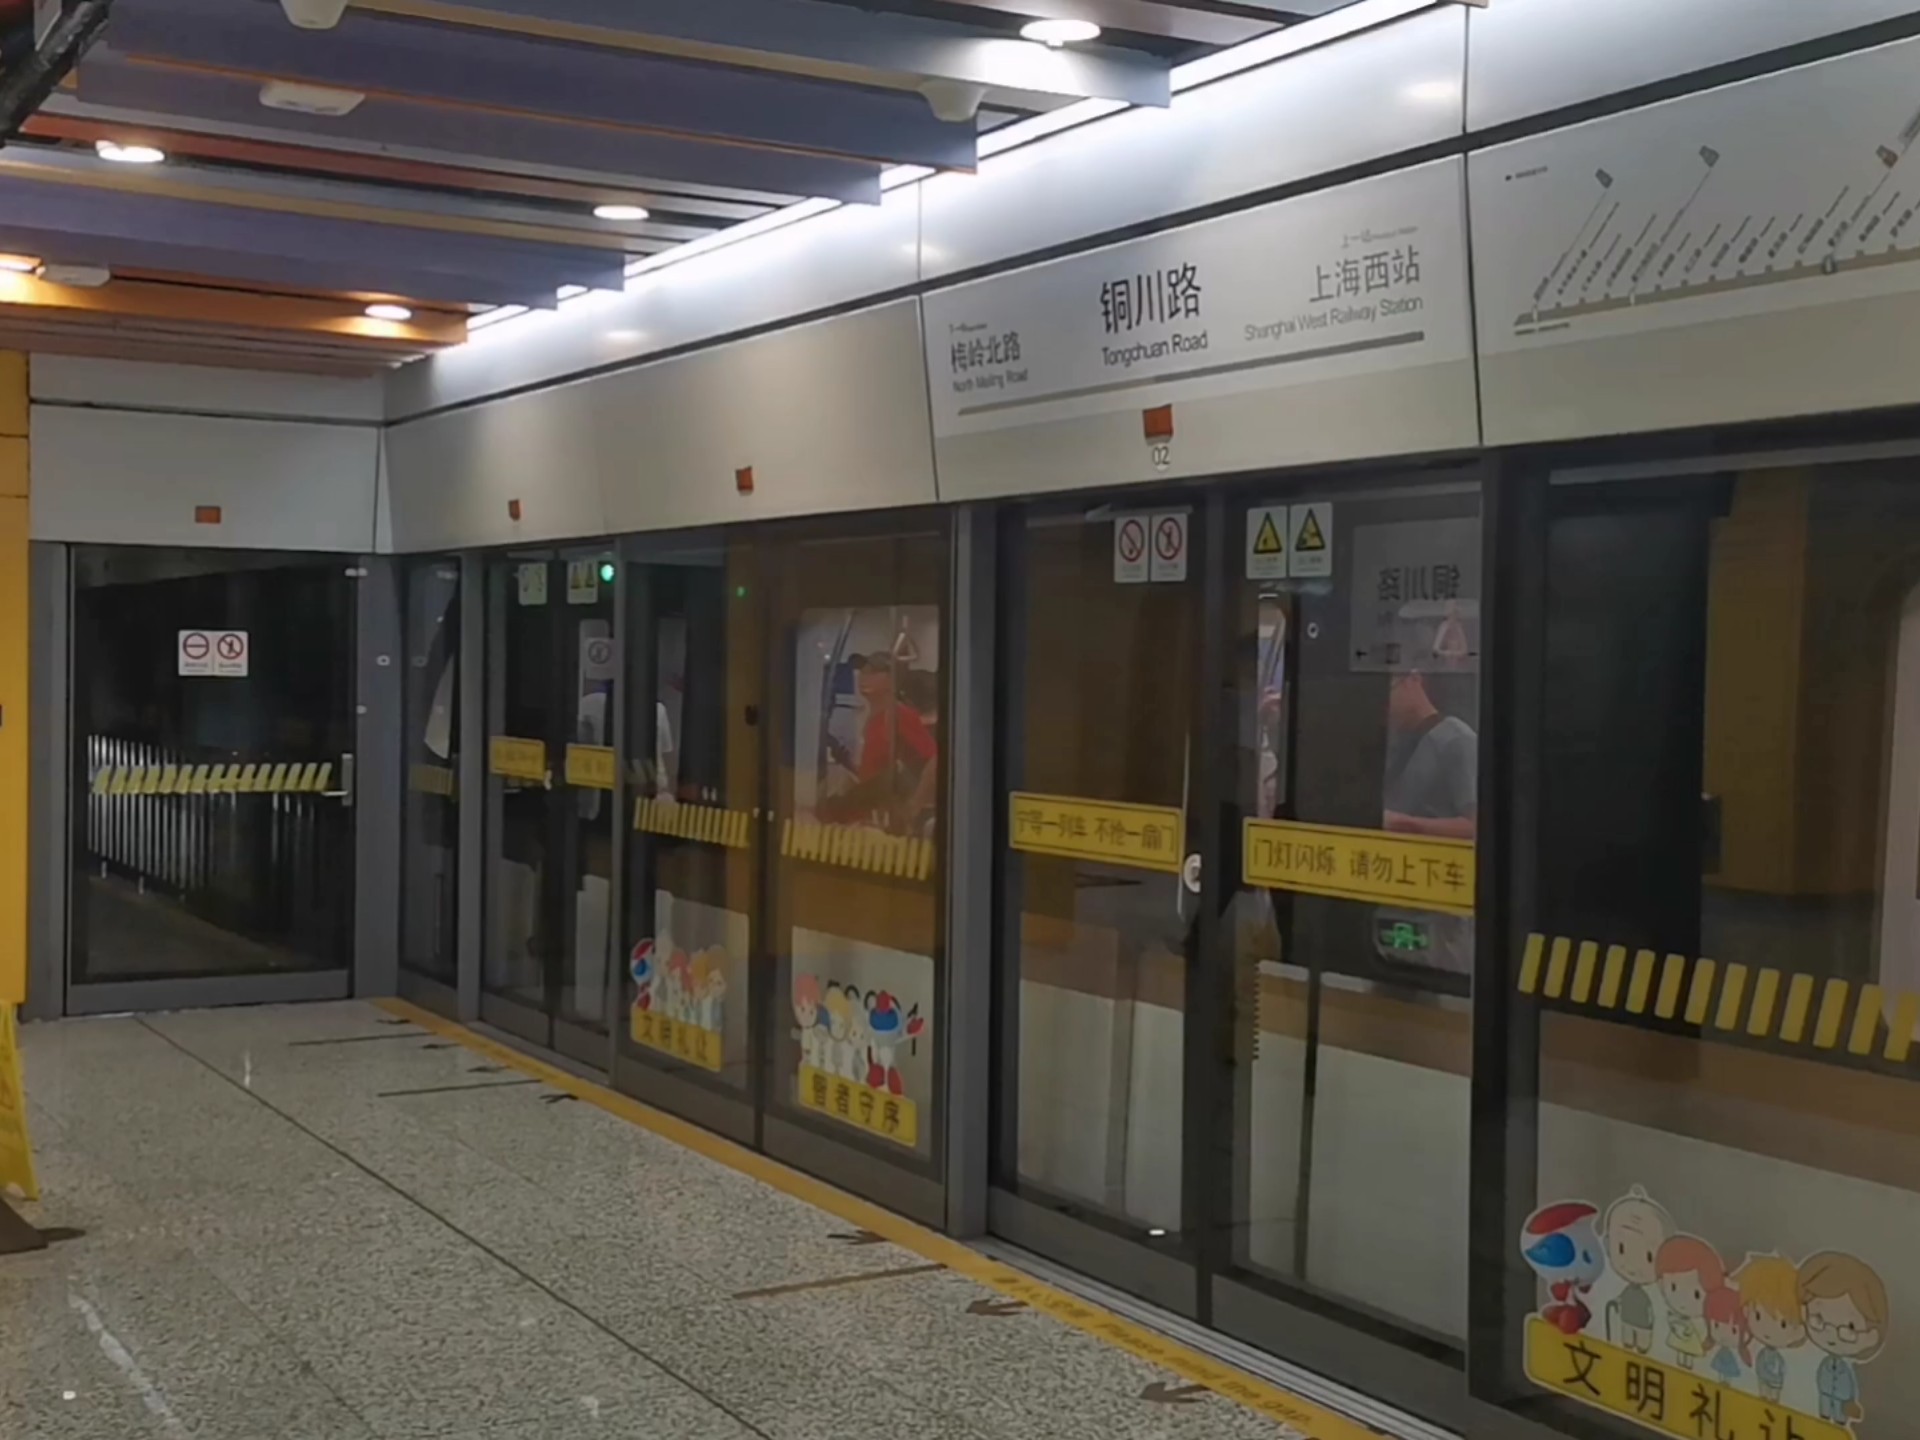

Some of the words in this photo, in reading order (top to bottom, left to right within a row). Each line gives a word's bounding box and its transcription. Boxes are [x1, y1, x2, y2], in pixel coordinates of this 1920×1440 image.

[1309, 244, 1420, 302] 上海西站
[1100, 262, 1201, 334] 铜川路
[1244, 321, 1296, 341] Shanghai
[1297, 311, 1328, 331] West
[1330, 304, 1377, 324] Railway
[1379, 296, 1424, 316] Station
[1101, 340, 1170, 368] Tongchuan
[1172, 330, 1208, 353] Road
[1151, 445, 1171, 466] 02
[1253, 839, 1338, 876] 门灯闪烁
[1350, 850, 1467, 892] 请勿上下车
